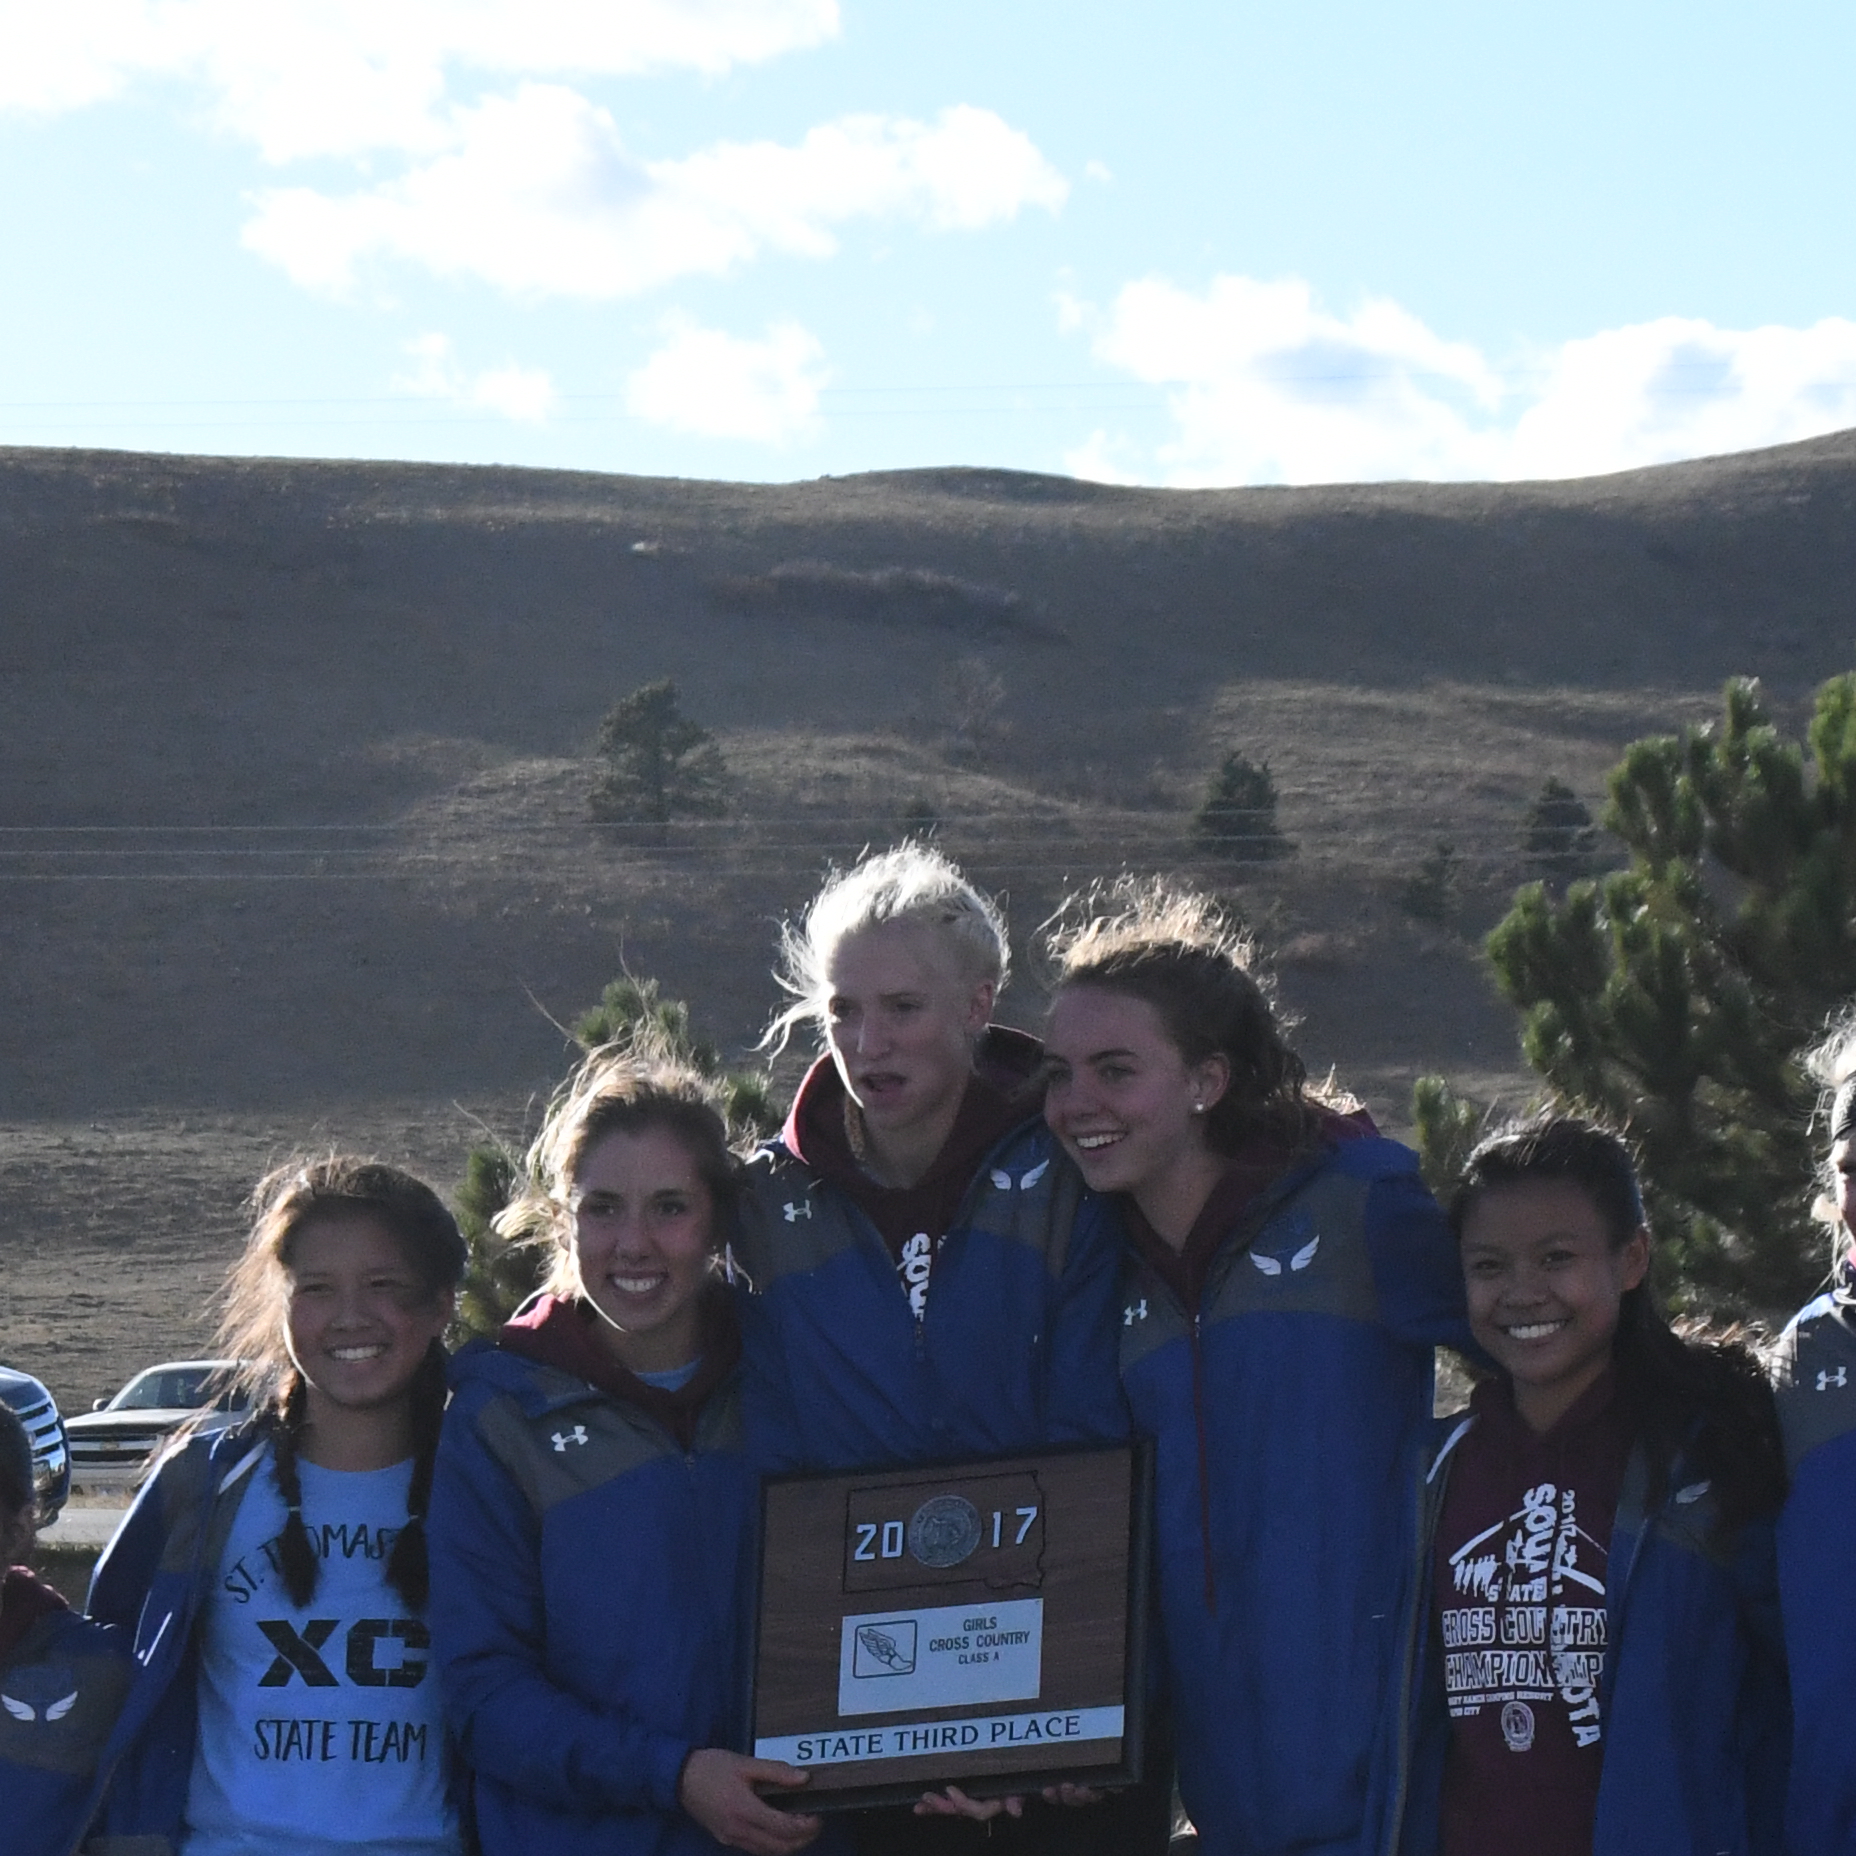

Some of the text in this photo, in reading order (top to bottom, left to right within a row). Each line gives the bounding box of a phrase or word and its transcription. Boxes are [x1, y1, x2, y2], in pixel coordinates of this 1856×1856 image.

[854, 1521, 904, 1561] 20
[992, 1506, 1038, 1548] 17
[224, 1524, 391, 1604] ST. TOMAS
[1487, 1578, 1547, 1603] SATE
[929, 1631, 1031, 1652] CROSS COUNTRY
[962, 1616, 997, 1632] GIRLS
[256, 1618, 431, 1687] XC
[958, 1652, 1000, 1665] CLASS A
[253, 1718, 427, 1763] STATE TEAM
[796, 1714, 1081, 1761] STATE THIRD PLACE
